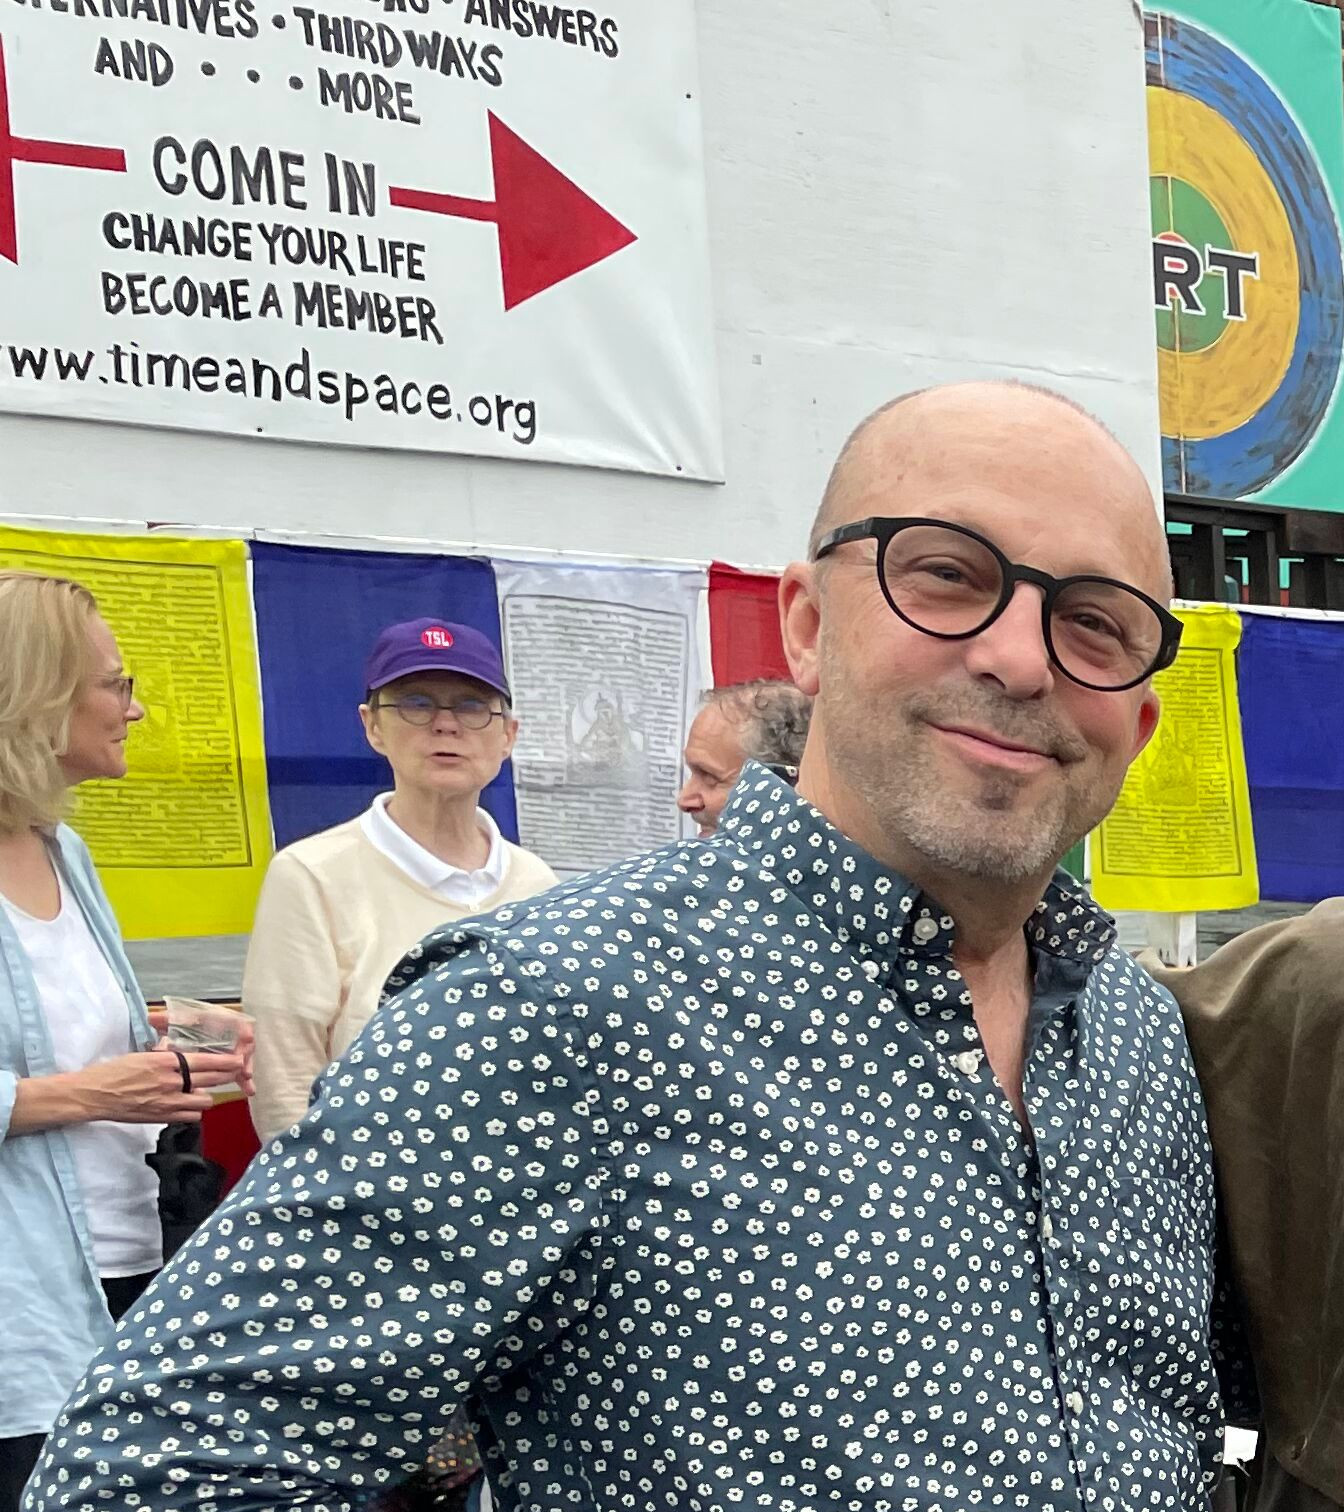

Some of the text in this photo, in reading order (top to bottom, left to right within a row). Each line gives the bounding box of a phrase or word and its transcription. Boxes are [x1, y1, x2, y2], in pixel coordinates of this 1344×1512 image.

[293, 7, 402, 68] THIRD
[402, 29, 503, 87] WAYS
[464, 0, 618, 58] ANSWERS
[94, 36, 421, 125] AND MORE
[153, 136, 377, 217] COME IN
[102, 211, 426, 281] CHANGE YOUR LIFE
[101, 271, 444, 344] BECOME A MEMBER
[0, 341, 536, 444] ww.timeandspace.org
[425, 631, 450, 647] TSL
